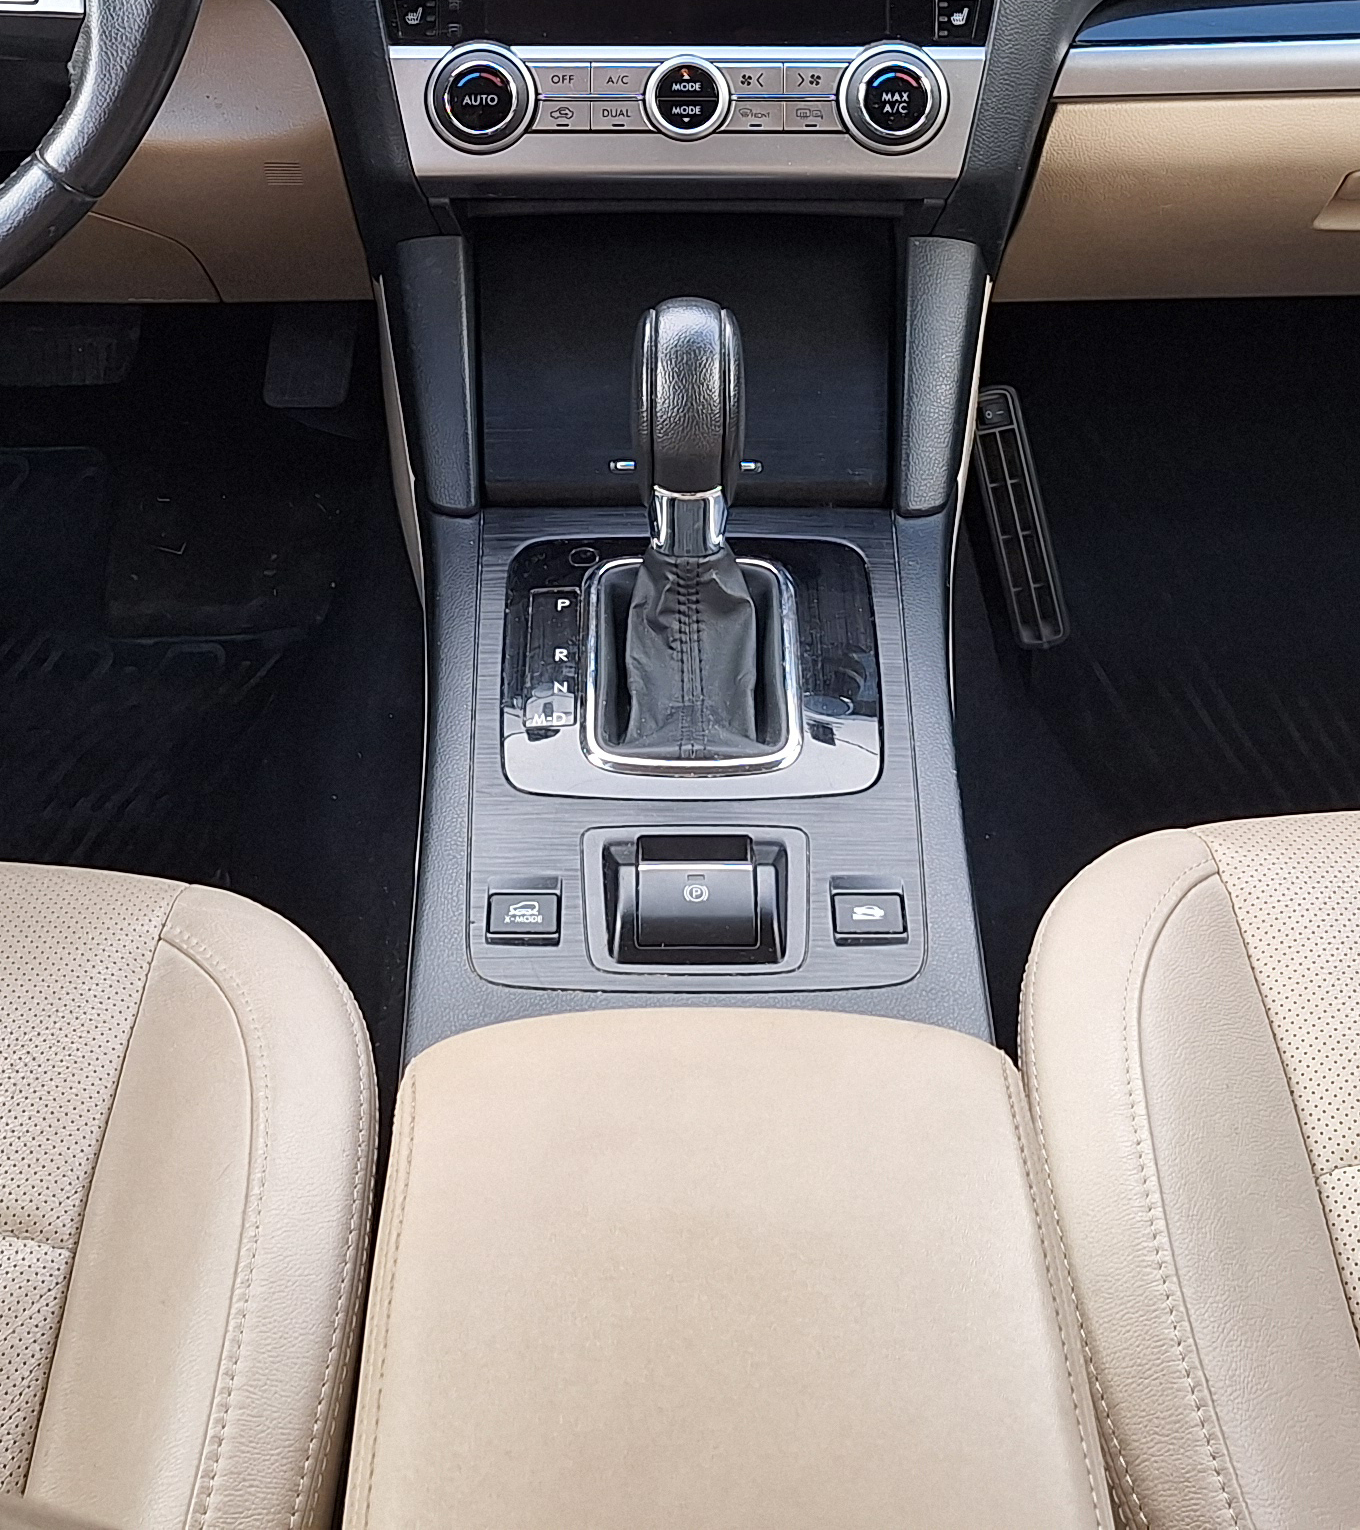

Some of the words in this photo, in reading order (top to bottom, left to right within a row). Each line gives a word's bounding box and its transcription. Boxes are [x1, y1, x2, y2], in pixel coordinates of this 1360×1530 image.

[551, 74, 575, 85] OFF
[606, 75, 629, 85] A/C
[671, 82, 702, 92] MODE
[462, 94, 498, 106] AUTO
[881, 92, 910, 102] MAX
[602, 108, 631, 118] DUAL
[671, 105, 702, 115] MODE
[883, 103, 908, 114] A/C
[557, 598, 570, 611] P
[554, 648, 568, 662] R
[553, 681, 568, 694] N
[532, 712, 566, 726] M-D
[503, 915, 543, 924] X-MODE
